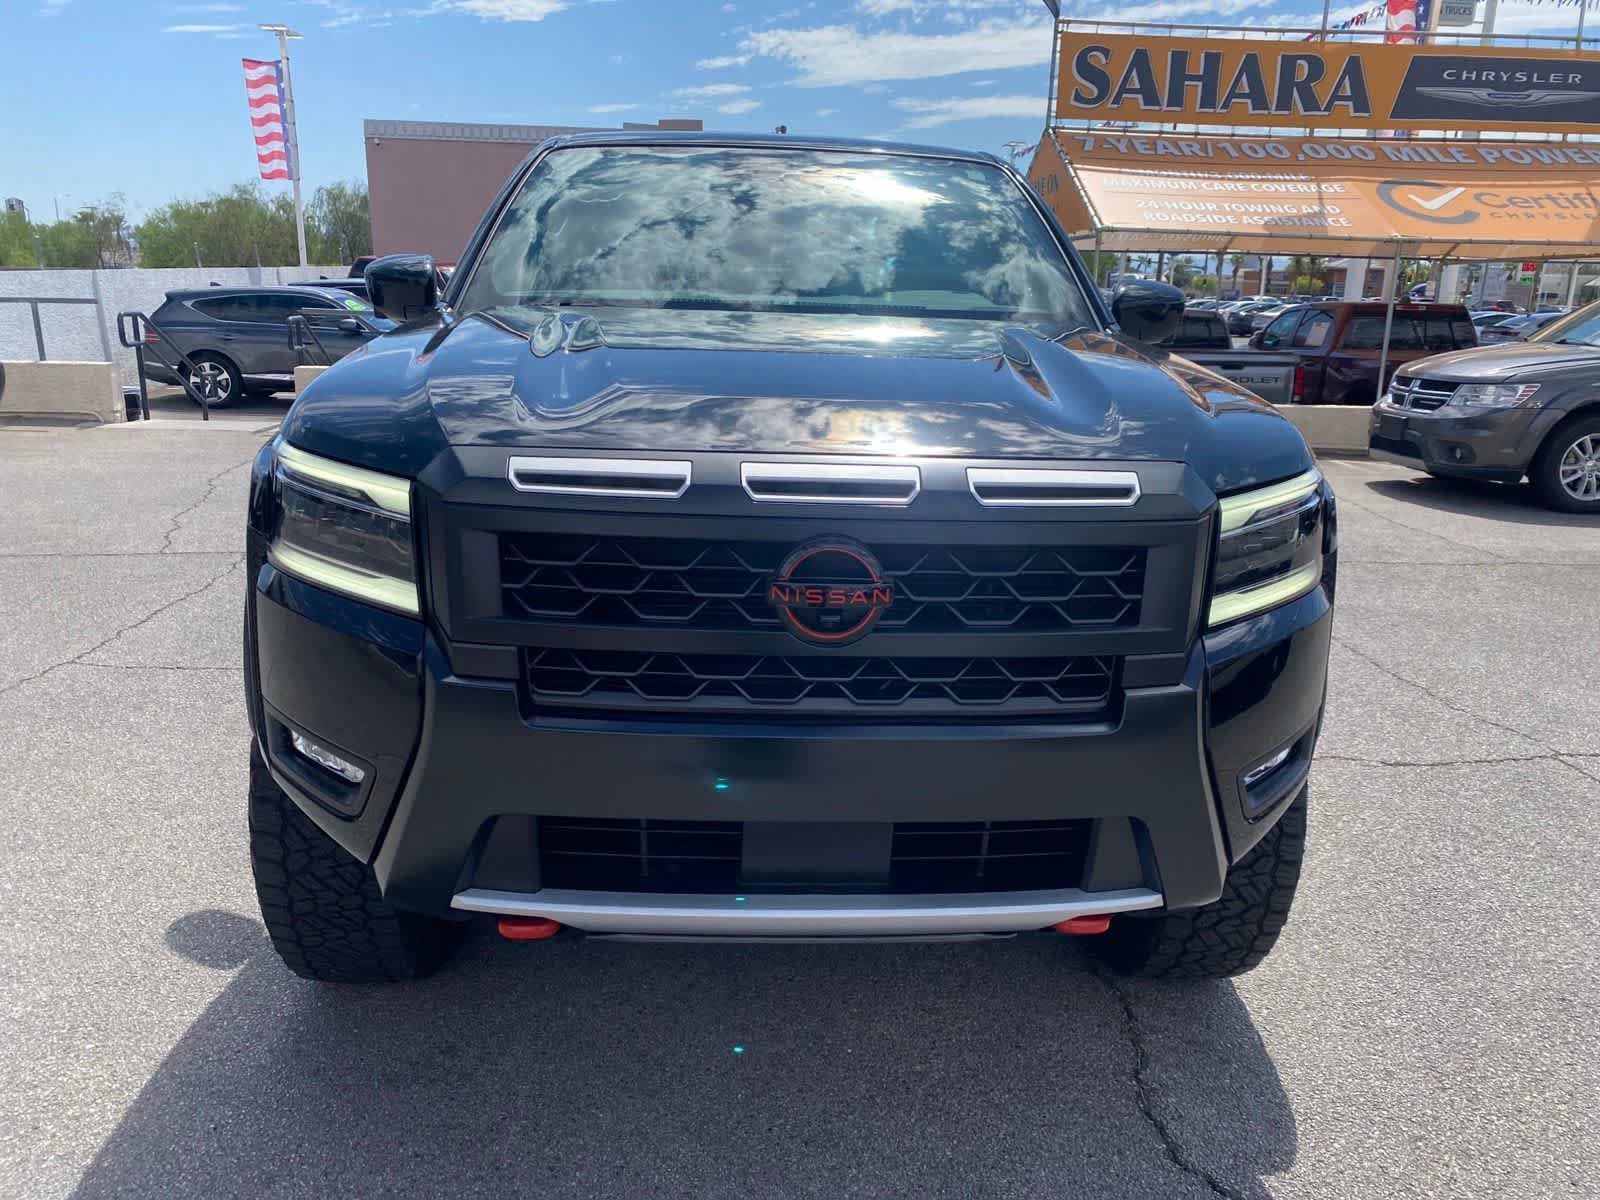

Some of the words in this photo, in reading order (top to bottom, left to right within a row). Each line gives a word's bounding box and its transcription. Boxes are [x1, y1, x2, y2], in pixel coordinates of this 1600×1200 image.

[1070, 44, 1372, 116] SAHARA
[1443, 69, 1583, 84] CHRYSLER
[1072, 135, 1376, 162] 7-YEAR/100,000
[1379, 145, 1476, 163] MILE
[1103, 177, 1197, 190] MAXIMUM
[1200, 181, 1248, 192] CARE
[1250, 183, 1345, 193] COVERAGE
[1136, 200, 1160, 209] 24
[1163, 201, 1218, 211] HOUR
[1222, 203, 1297, 213] TOWING
[1301, 204, 1341, 214] AND
[1143, 212, 1239, 224] ROADSIDE
[1242, 215, 1353, 227] ASSISTANCE
[770, 585, 891, 605] NISSAN
